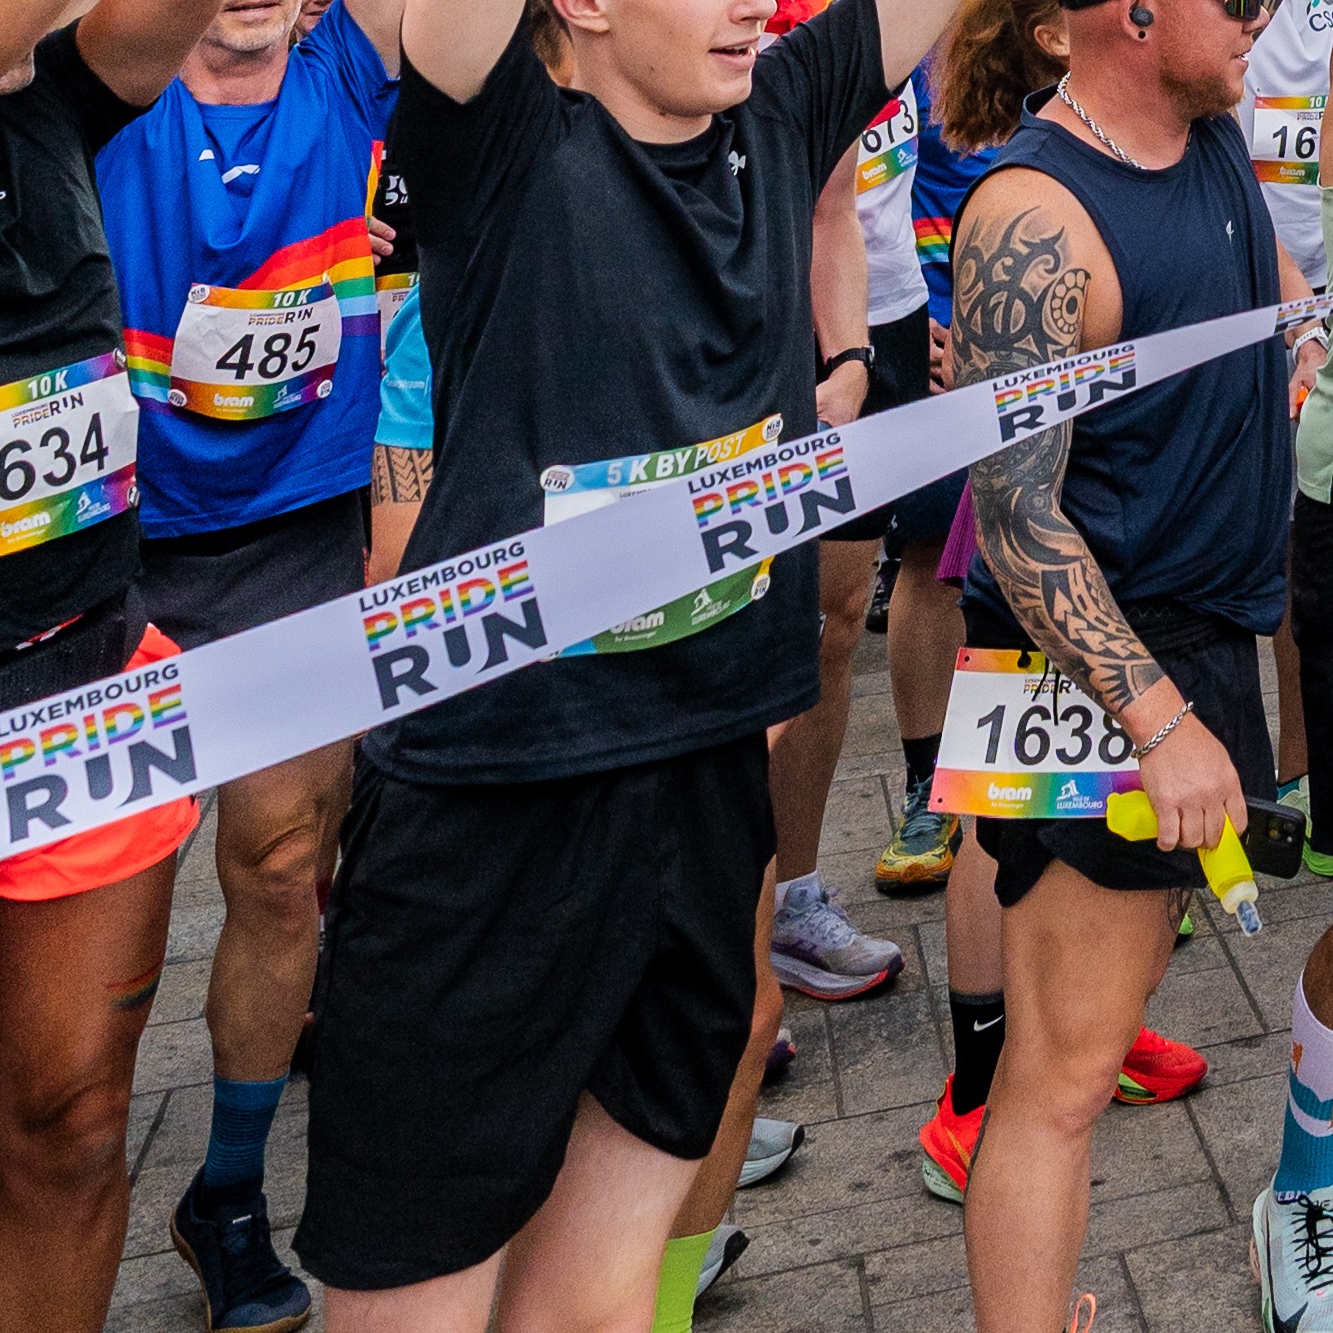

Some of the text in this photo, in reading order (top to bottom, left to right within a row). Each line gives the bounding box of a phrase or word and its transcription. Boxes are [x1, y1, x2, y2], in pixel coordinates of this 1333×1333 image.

[248, 316, 285, 326] PRIDE
[272, 289, 313, 307] 10 K
[215, 323, 321, 380] 485
[992, 343, 1136, 392] LUXEMBOURG
[28, 369, 69, 400] 10 K
[213, 393, 254, 407] bram
[992, 352, 1138, 413] PRIDE
[996, 369, 1139, 443] RUN
[12, 407, 50, 429] PRIDE
[0, 412, 109, 500] 634
[606, 431, 748, 485] 5 K BY POST
[687, 431, 842, 495] LUXEMBOURG
[692, 445, 848, 528] PRIDE
[0, 511, 51, 538] bram
[699, 476, 858, 575] RUN
[358, 541, 527, 613] LUXEMBOURG
[363, 560, 536, 651] PRIDE
[371, 597, 548, 710] RUN
[0, 683, 190, 780] PRIDE
[976, 704, 1135, 766] 1638
[5, 724, 198, 842] RUN
[987, 783, 1032, 801] bram
[1056, 801, 1103, 809] LUXEMBOURG
